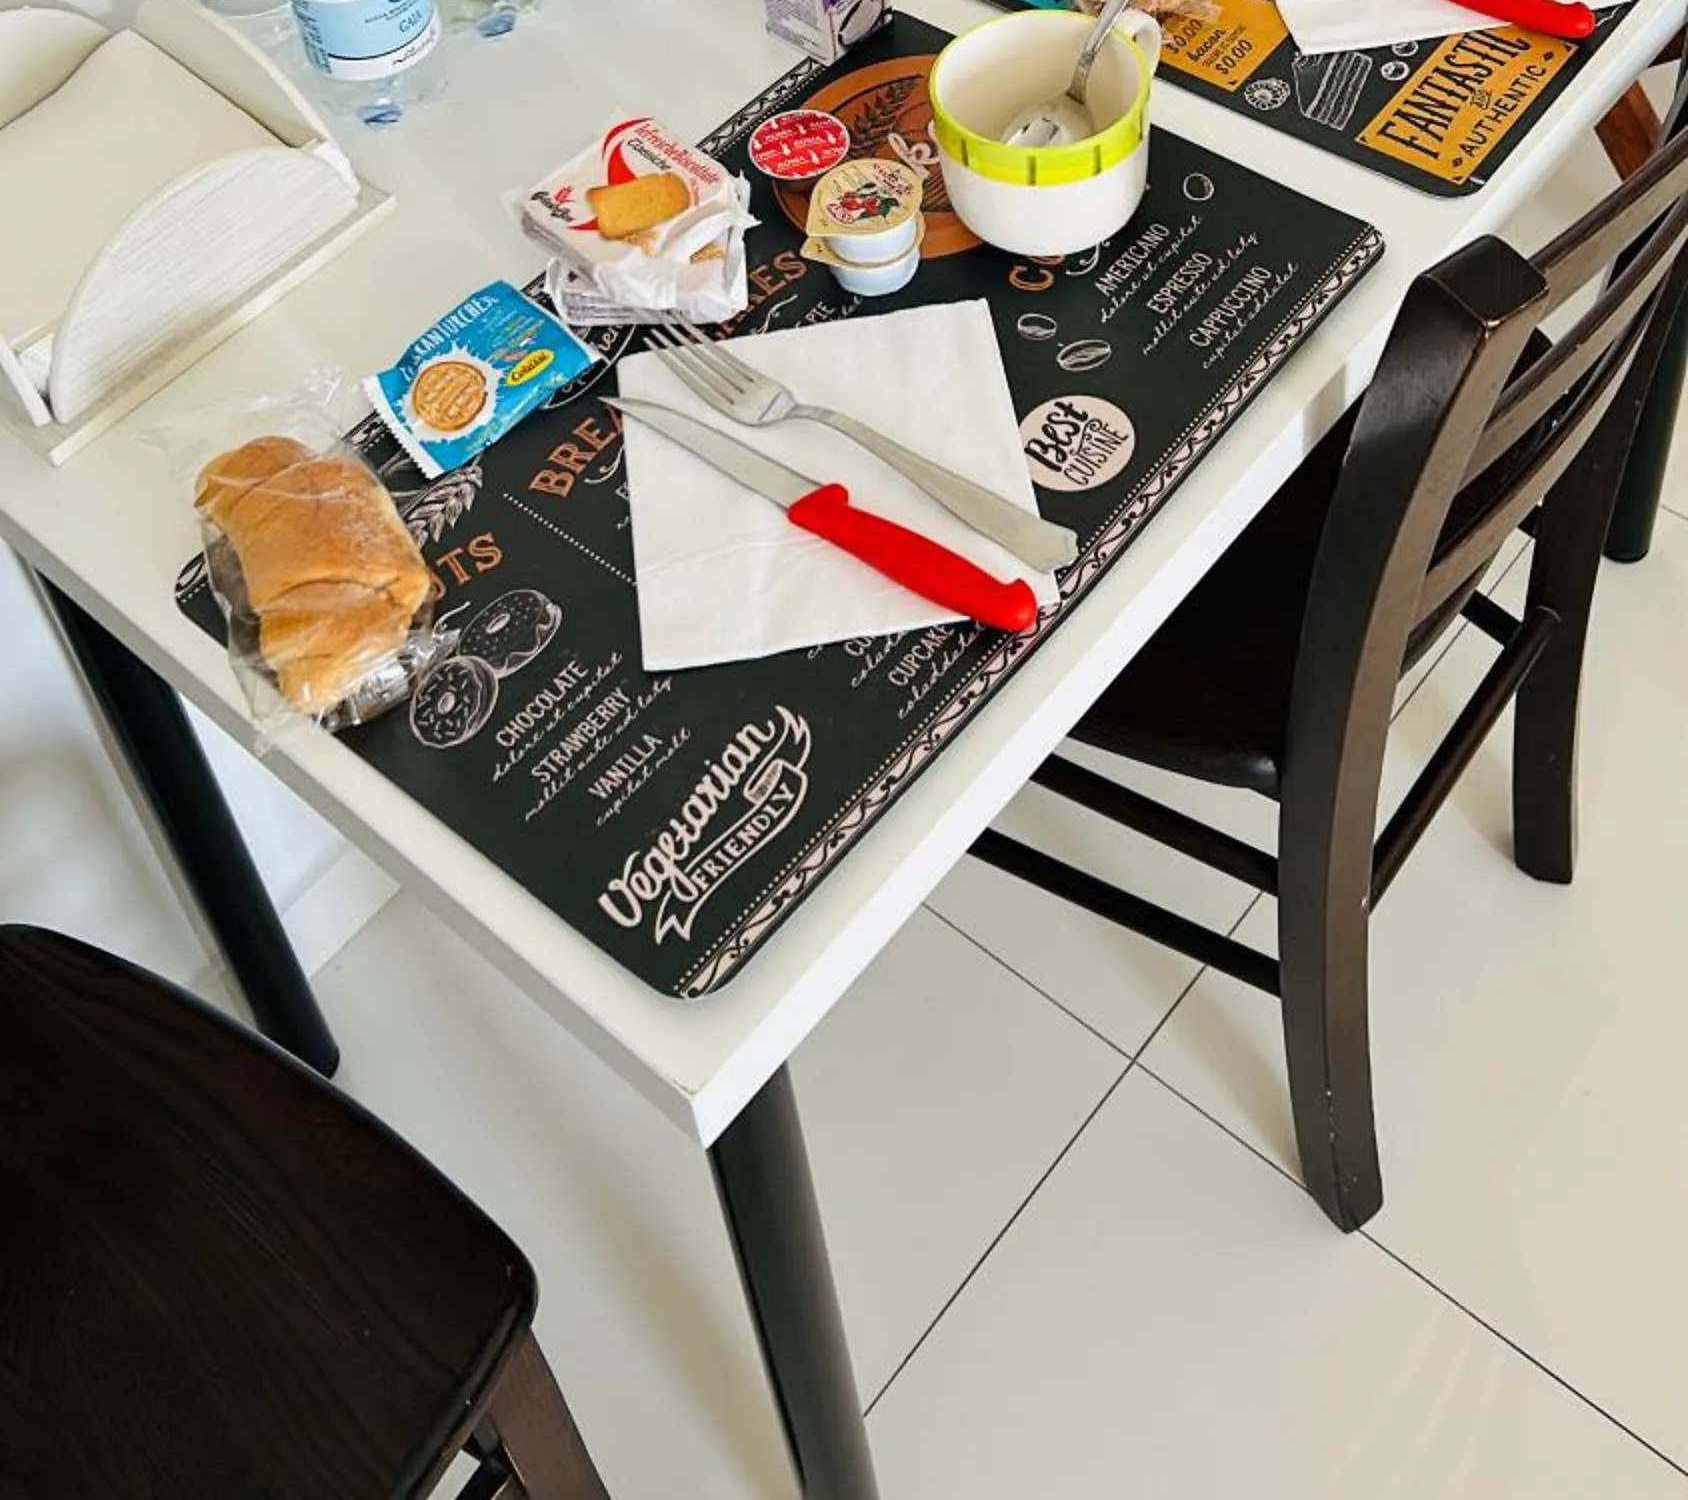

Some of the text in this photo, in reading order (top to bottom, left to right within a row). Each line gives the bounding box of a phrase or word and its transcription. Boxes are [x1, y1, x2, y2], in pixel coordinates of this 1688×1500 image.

[1215, 39, 1253, 75] $0.00
[1459, 64, 1547, 159] AUTHENTIC
[1095, 224, 1169, 296] AMERICANO
[1147, 253, 1212, 313] ESPRESSO
[1190, 267, 1277, 346] CAPPUCCINO
[1023, 401, 1089, 473] Best
[1063, 418, 1129, 486] CUISINE
[496, 661, 588, 746] CHOCOLATE
[531, 687, 630, 782] STRAWBERRY
[589, 735, 662, 798] VANILLA
[598, 719, 776, 928] Vegetarian
[690, 782, 796, 891] FRIENDLY
